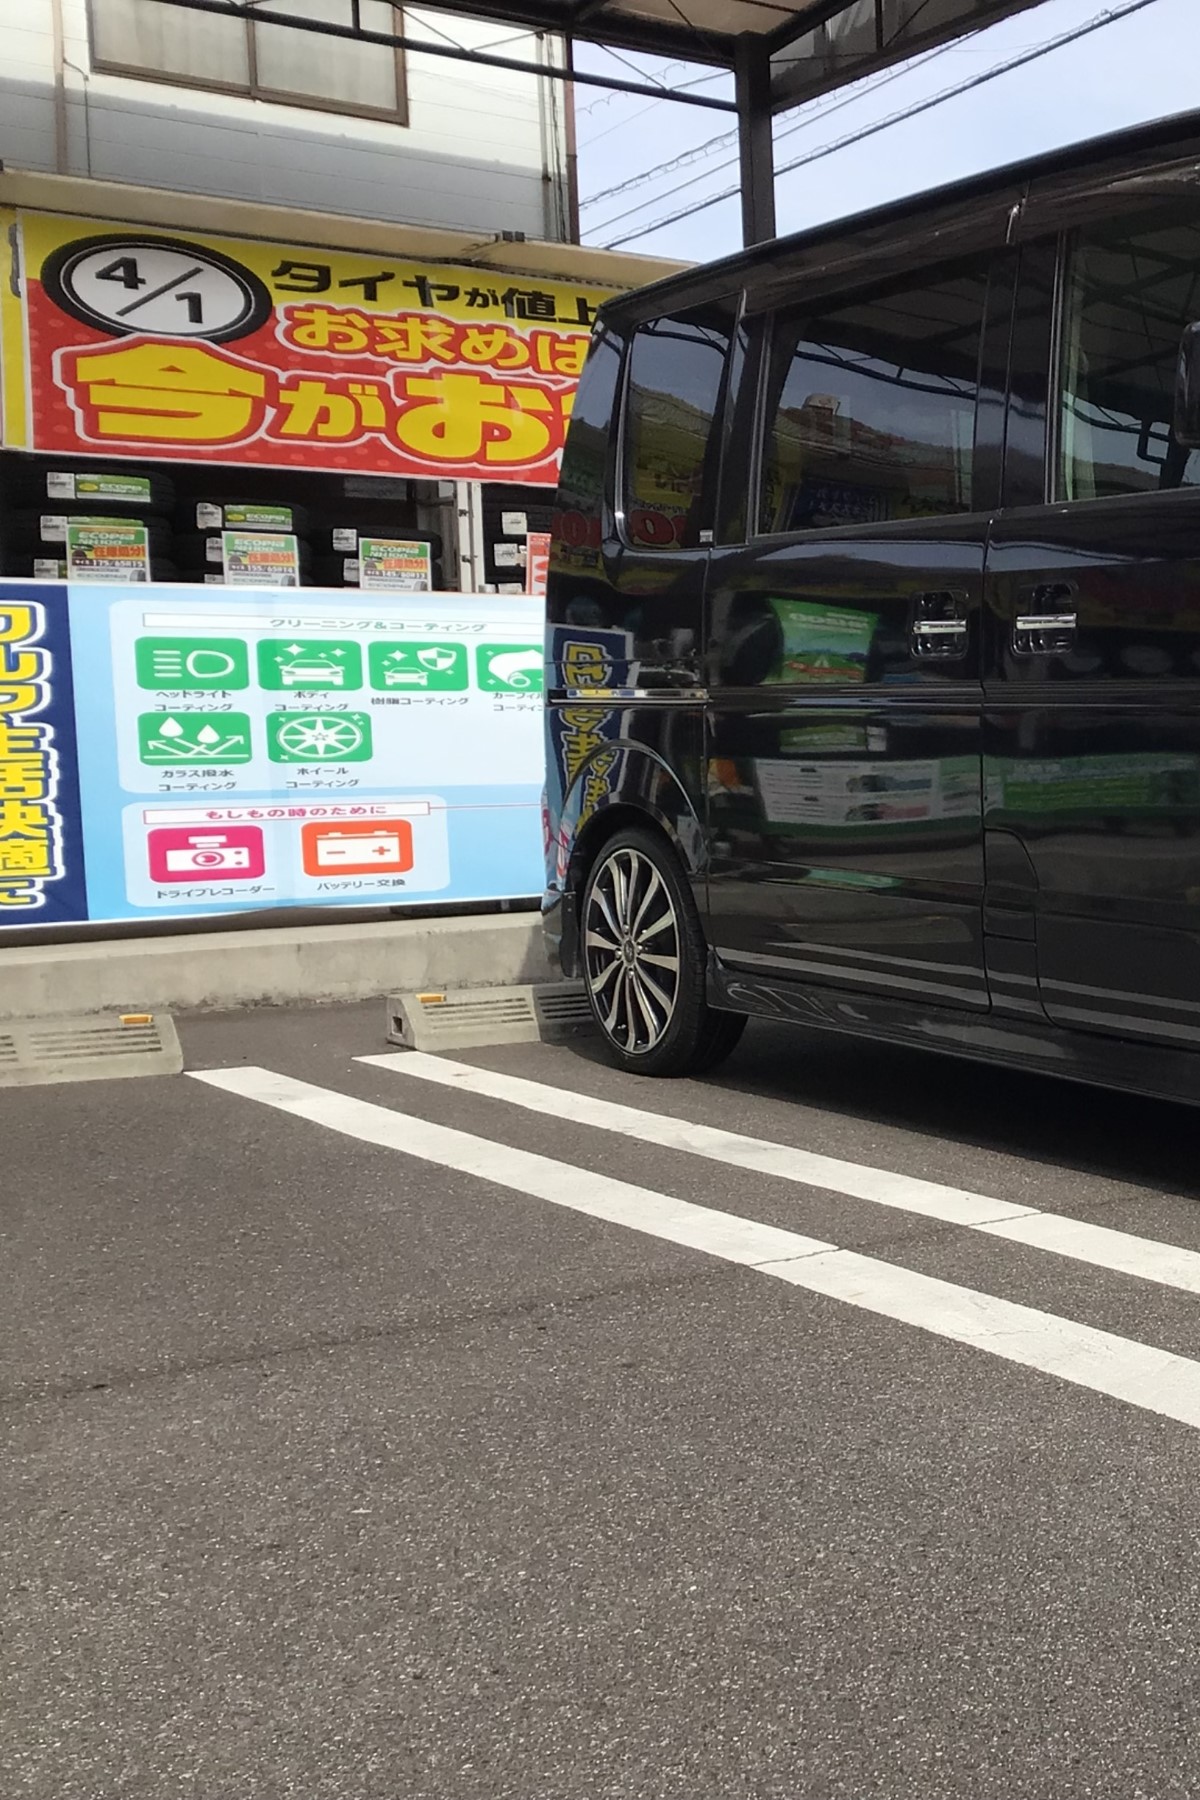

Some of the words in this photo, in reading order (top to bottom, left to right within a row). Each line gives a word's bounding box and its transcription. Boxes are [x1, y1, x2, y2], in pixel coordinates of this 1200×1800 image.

[94, 255, 204, 325] 4/1
[271, 260, 597, 325] タイヤが値上
[293, 308, 588, 375] お求めは
[77, 343, 576, 461] 今がお
[155, 690, 232, 699] ヘッドライト
[154, 703, 234, 712] コーティング
[275, 703, 349, 712] コーティング
[297, 767, 349, 776] ホイール
[158, 781, 237, 792] コーティング
[286, 778, 360, 789] コーティング
[205, 806, 387, 820] もしもの時のために
[317, 878, 406, 891] バッテリー交換
[157, 885, 275, 899] ドライブレコーダー
